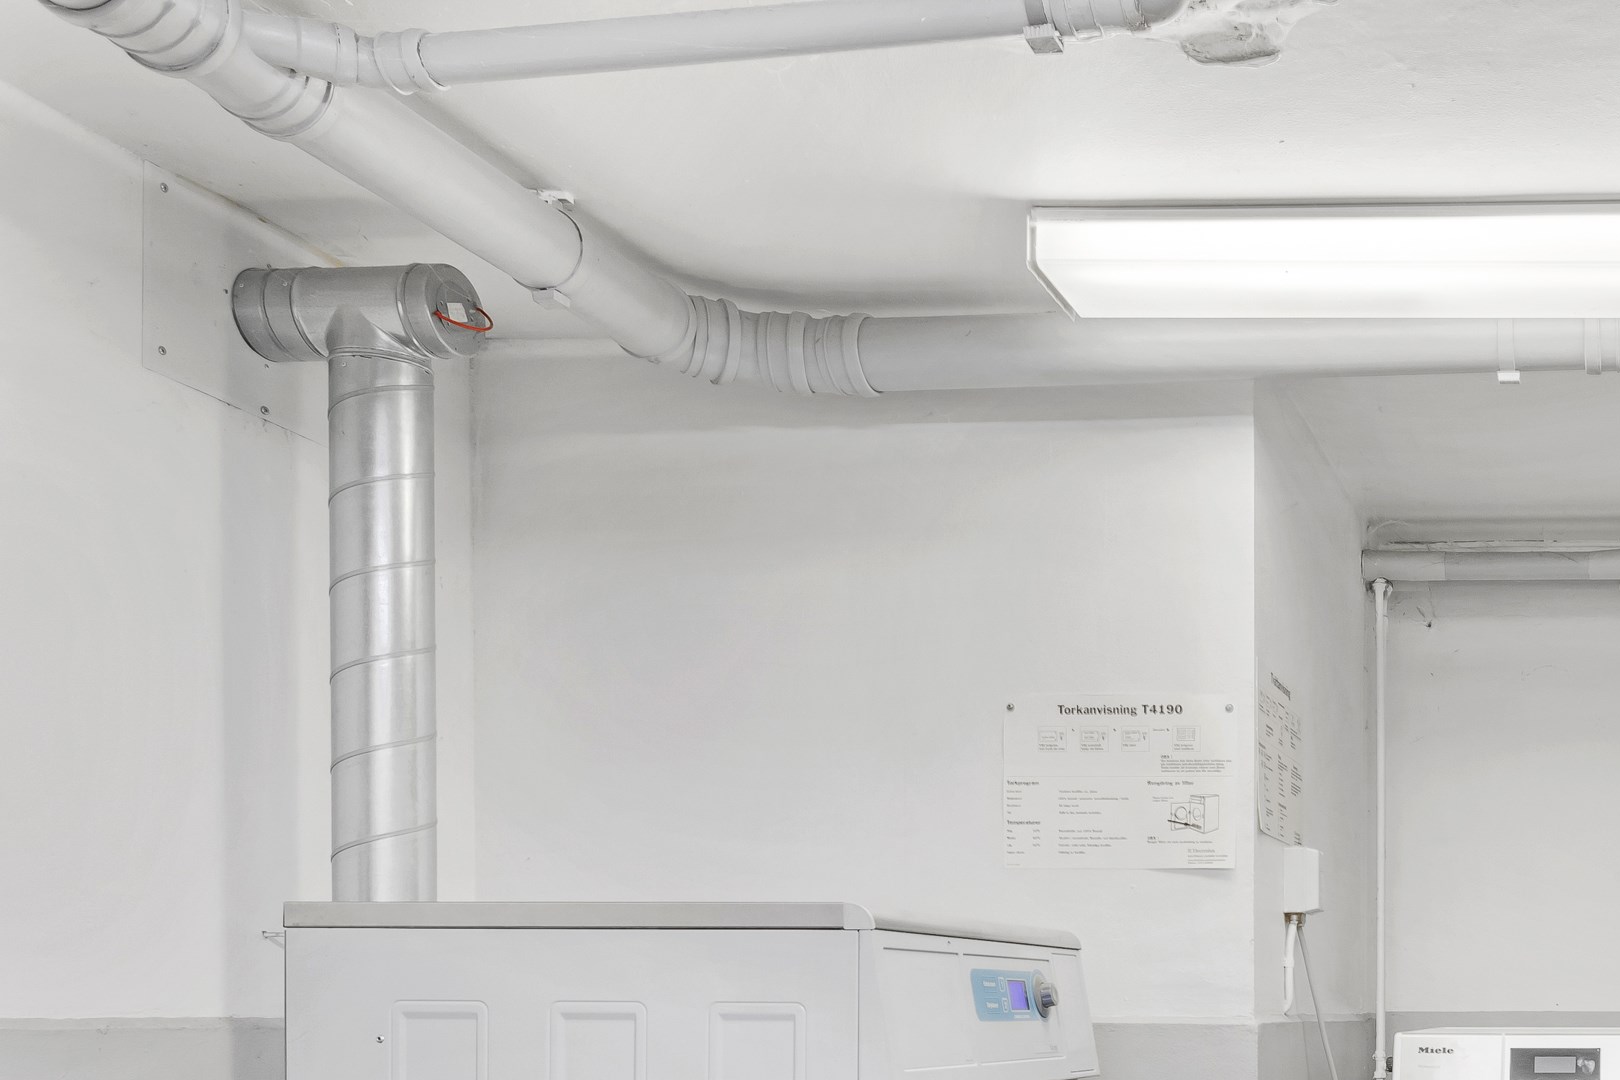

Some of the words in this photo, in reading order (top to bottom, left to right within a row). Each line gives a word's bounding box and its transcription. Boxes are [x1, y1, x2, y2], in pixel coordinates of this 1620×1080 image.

[1057, 704, 1138, 717] Torkanvisning
[1142, 704, 1183, 715] T4190
[1418, 1046, 1454, 1054] Miele
